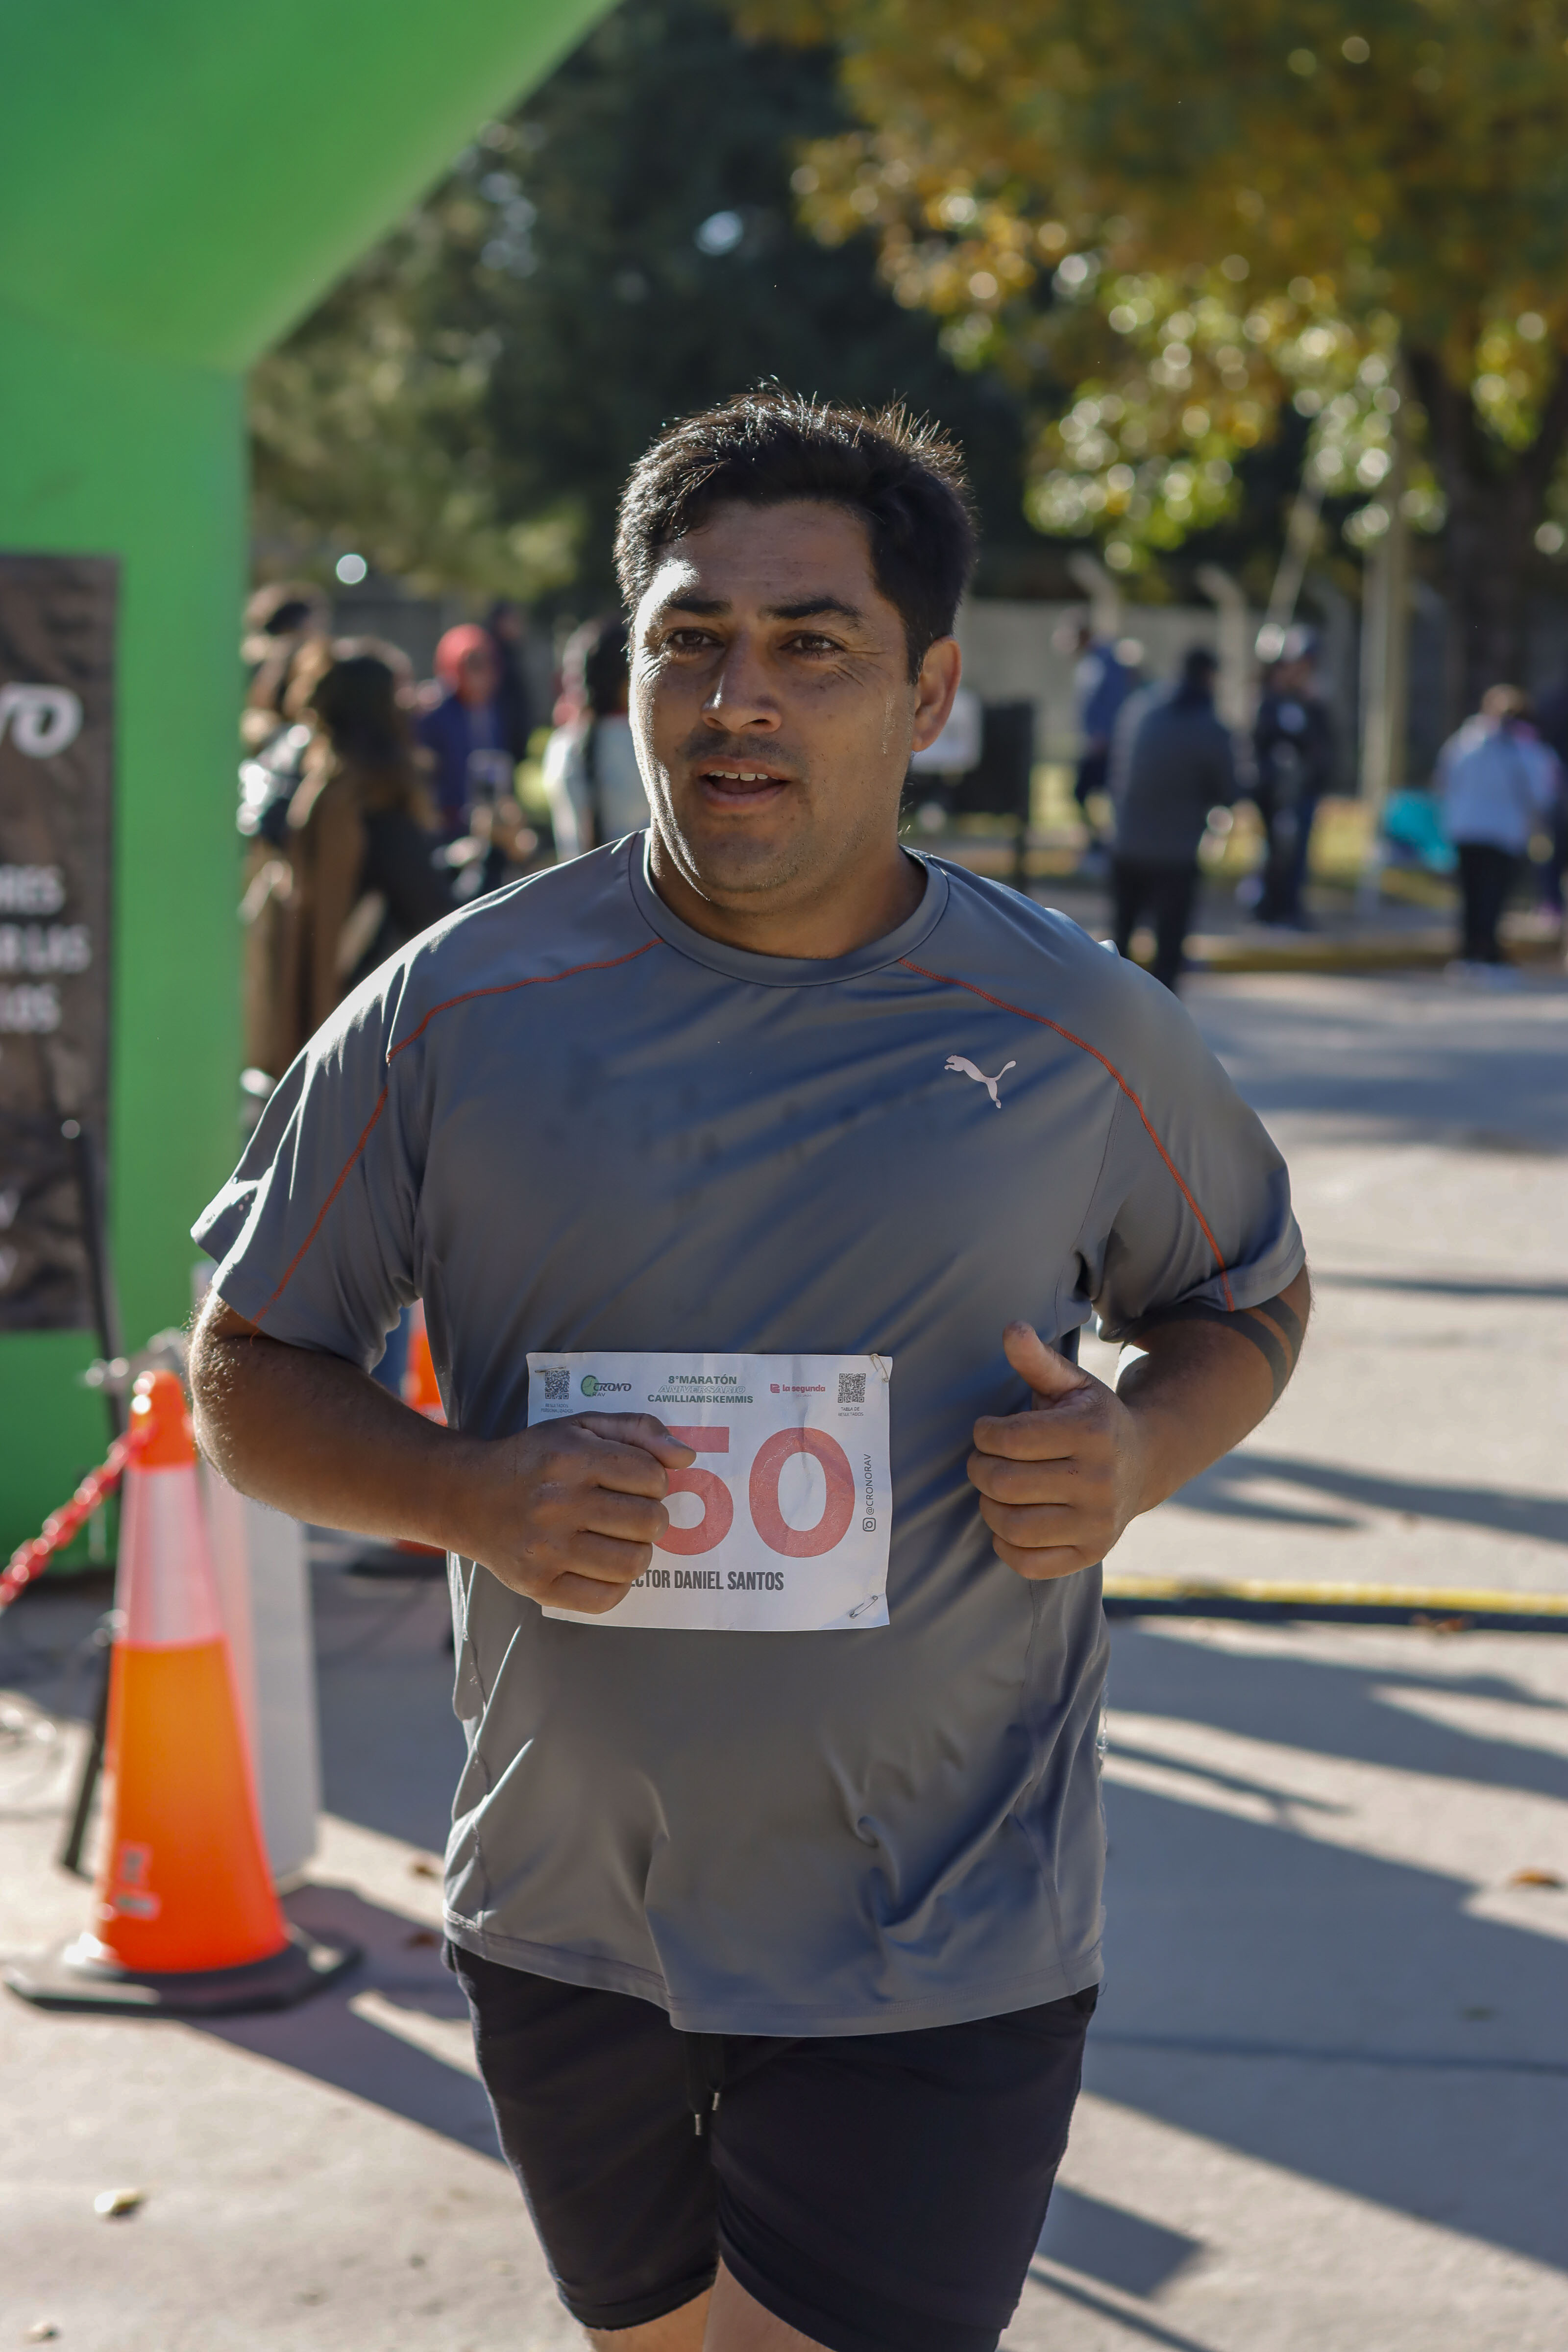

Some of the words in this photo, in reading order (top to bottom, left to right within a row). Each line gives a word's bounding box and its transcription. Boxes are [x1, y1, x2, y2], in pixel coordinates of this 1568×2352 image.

[658, 1385, 746, 1394] ANIVERSARIO
[791, 1384, 826, 1393] segunda
[647, 1394, 754, 1403] CAWILLIAMSKEMMIS
[863, 1454, 875, 1515] @CRONORAV
[674, 1570, 724, 1590] DANIEL
[727, 1571, 784, 1591] SANTOS
